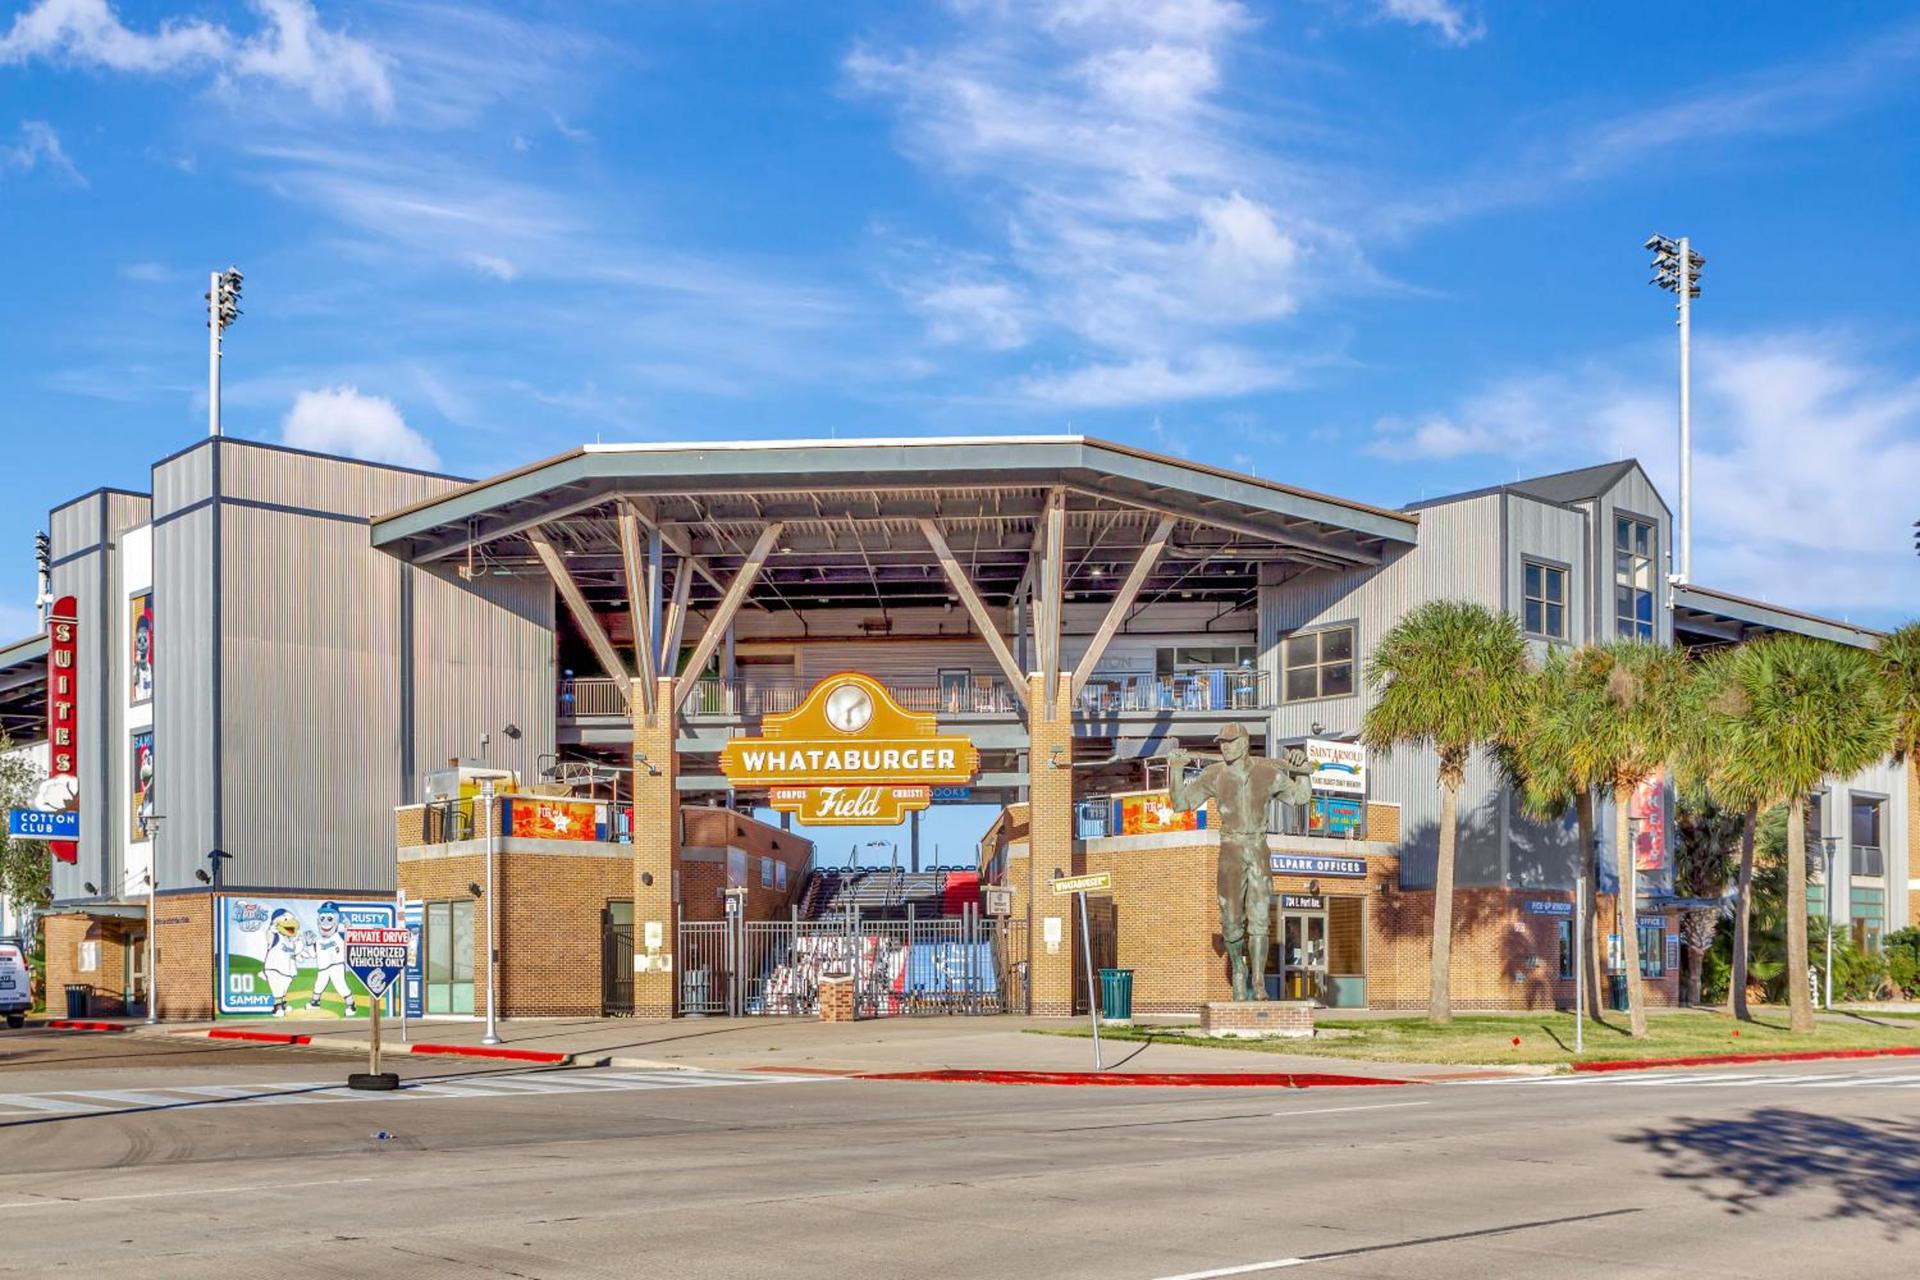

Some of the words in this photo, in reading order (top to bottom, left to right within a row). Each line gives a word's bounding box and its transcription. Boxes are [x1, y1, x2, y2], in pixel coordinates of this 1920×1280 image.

[55, 624, 71, 771] SUITES
[1310, 744, 1332, 759] SAINT
[742, 749, 955, 772] WHATABURGER
[776, 790, 807, 799] CORPUS
[892, 789, 924, 799] CHRISTI
[934, 787, 966, 798] OOKS
[816, 786, 881, 817] Field
[20, 812, 75, 824] COTTON
[20, 822, 53, 833] CLUB
[1273, 859, 1313, 870] LLPARK
[1316, 861, 1361, 872] OFFICES
[351, 913, 385, 923] RUSTY
[1639, 918, 1661, 926] OFFICE
[347, 930, 380, 943] PRIVATE
[383, 931, 408, 943] DRIVE
[350, 946, 405, 958] AUTHORIZED
[350, 956, 384, 967] VEHICLES
[384, 958, 405, 968] ONLY
[229, 974, 255, 993] 00
[229, 994, 271, 1005] SAMMY
